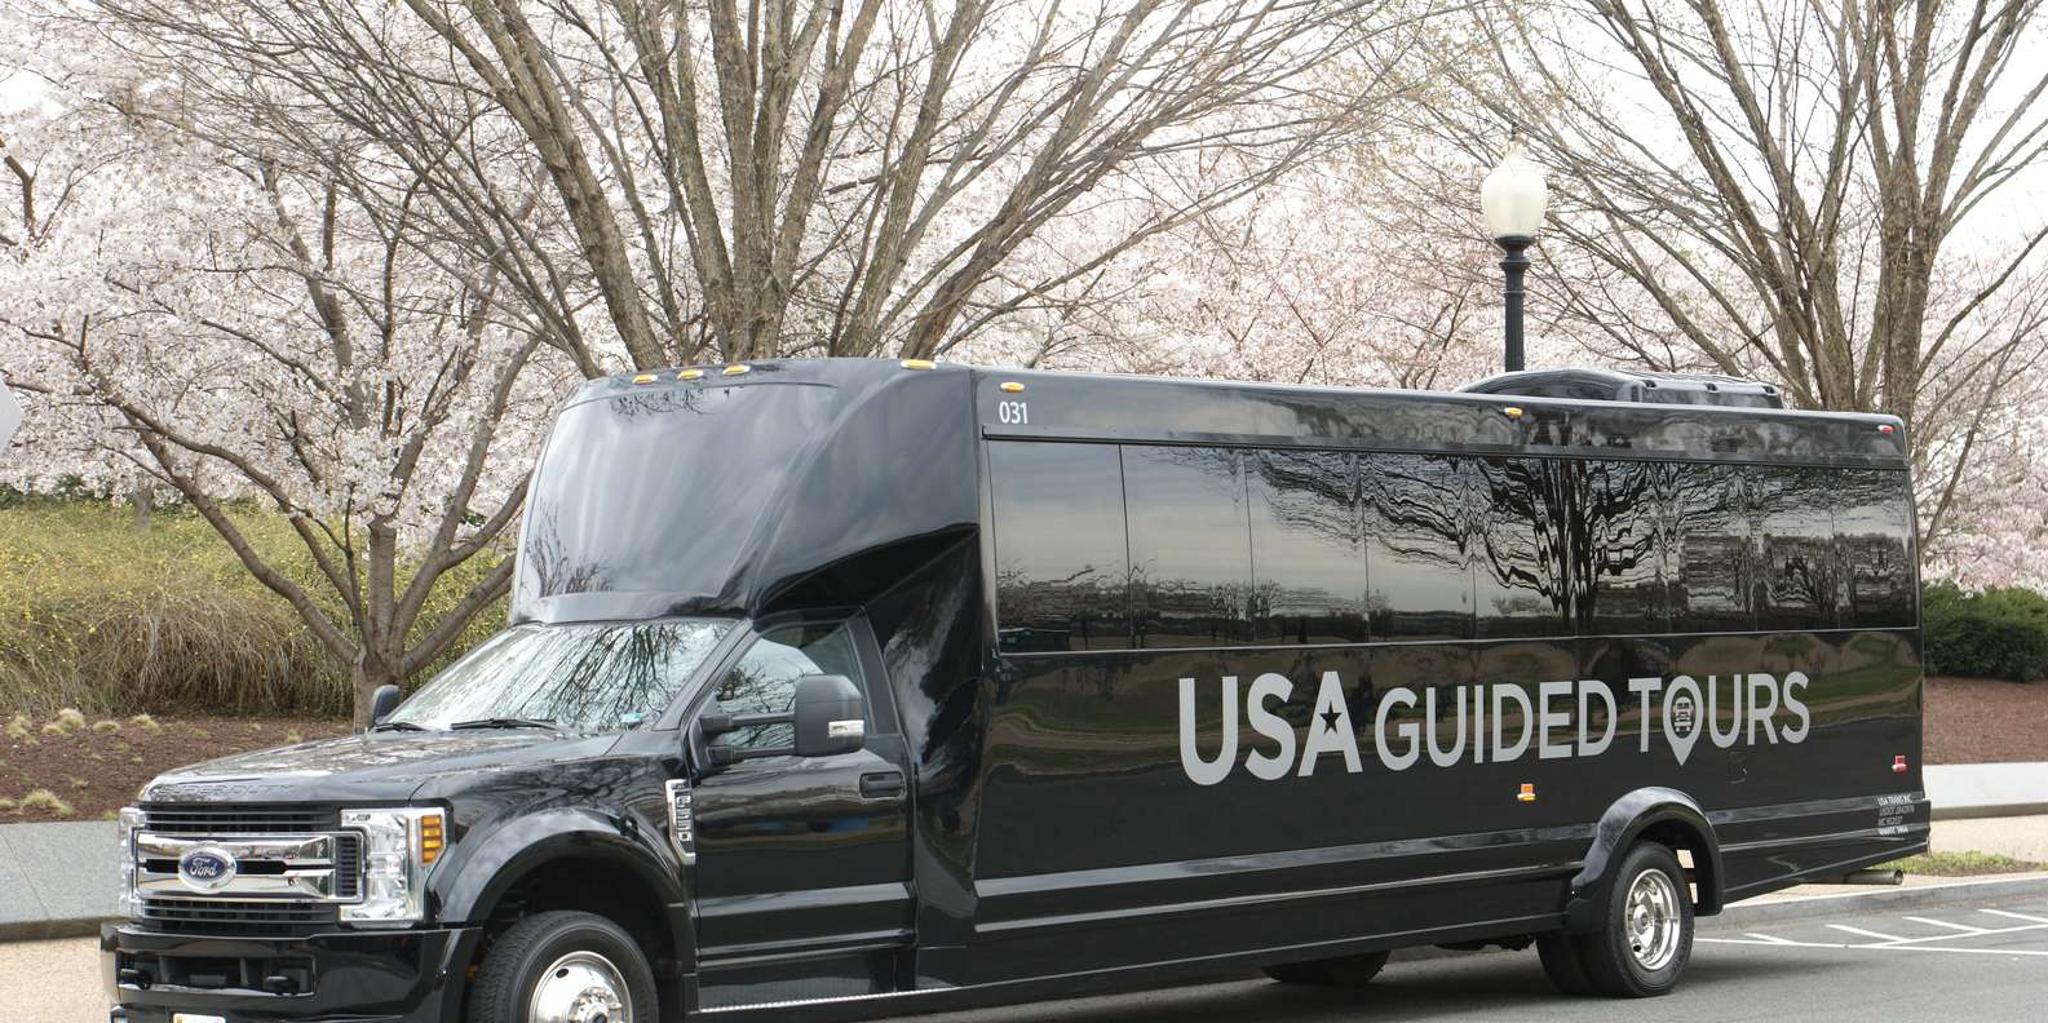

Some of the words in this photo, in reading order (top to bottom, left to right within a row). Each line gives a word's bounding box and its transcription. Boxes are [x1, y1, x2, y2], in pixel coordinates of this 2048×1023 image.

[999, 401, 1028, 424] 031
[1178, 671, 1363, 785] USA
[1374, 680, 1617, 771] GUIDED
[1628, 671, 1810, 766] TOURS
[190, 857, 218, 878] Ford
